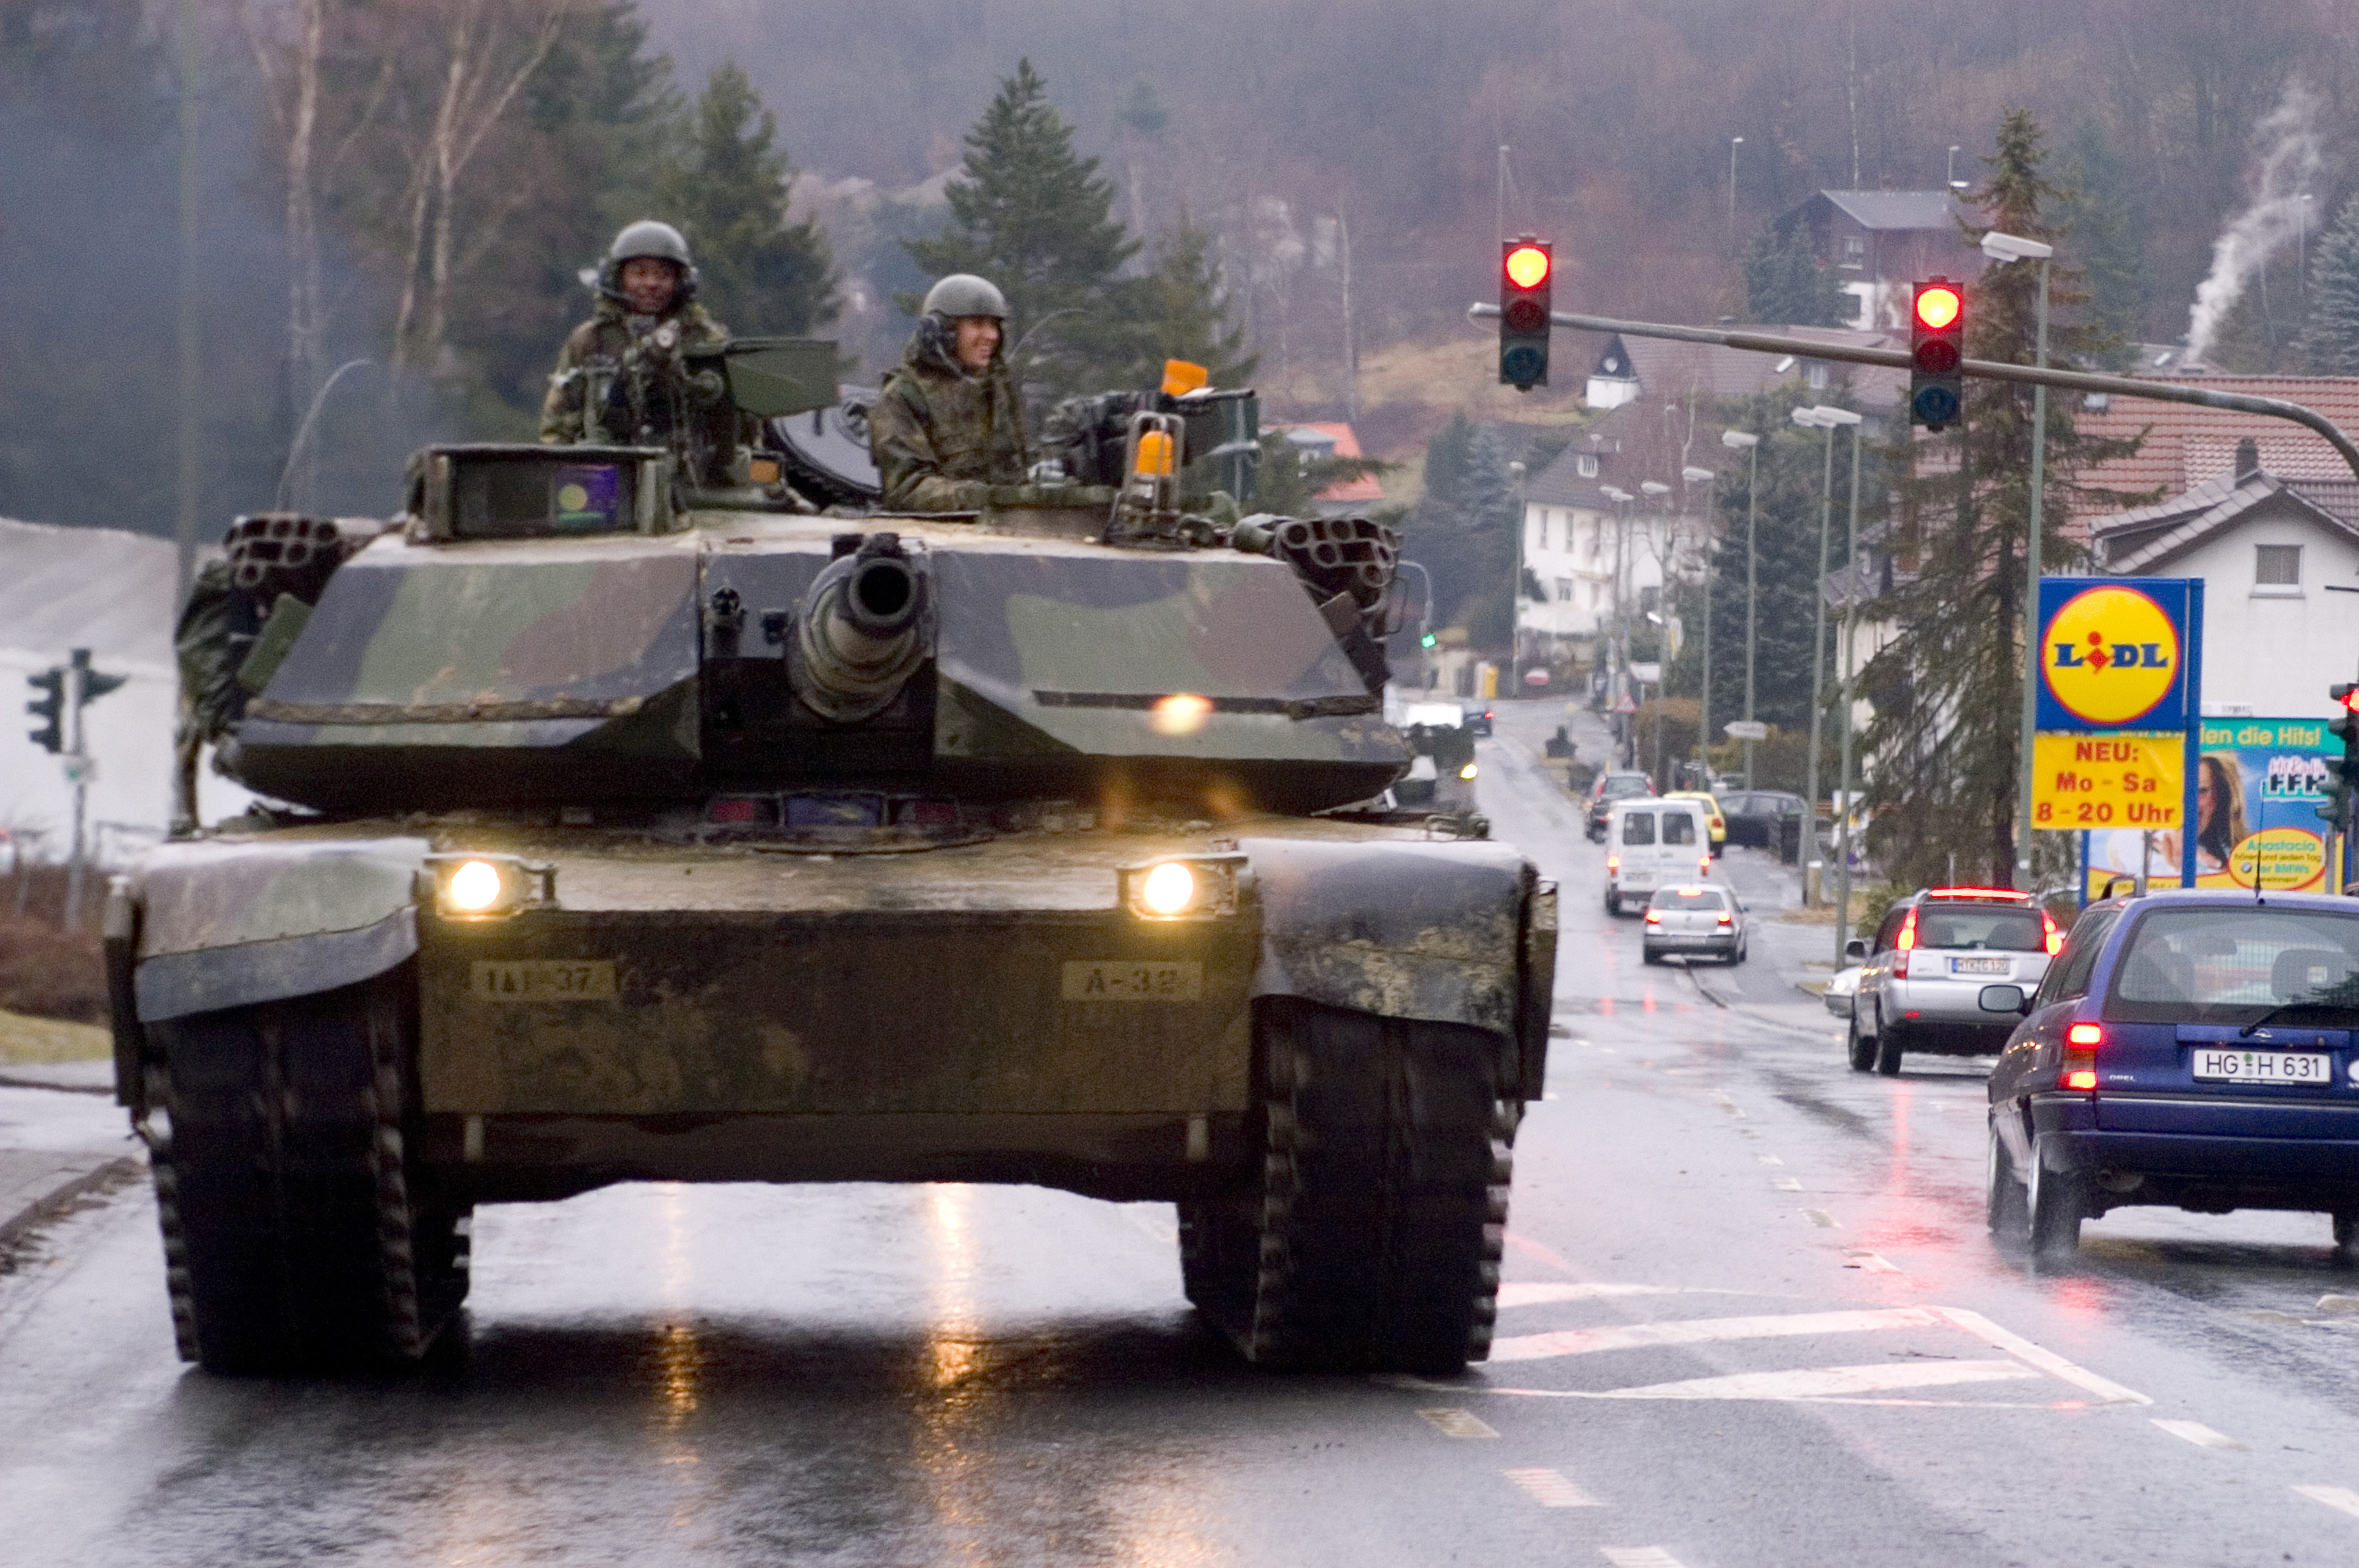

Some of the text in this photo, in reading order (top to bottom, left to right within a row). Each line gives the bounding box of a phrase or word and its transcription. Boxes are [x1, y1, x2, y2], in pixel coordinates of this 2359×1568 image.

[2237, 726, 2274, 746] die
[2278, 727, 2321, 746] Hits!
[2076, 742, 2139, 762] NEU:
[2056, 772, 2093, 792] Mo
[2123, 771, 2157, 793] Sa
[2128, 802, 2175, 822] Uhr
[2283, 1056, 2319, 1077] 631
